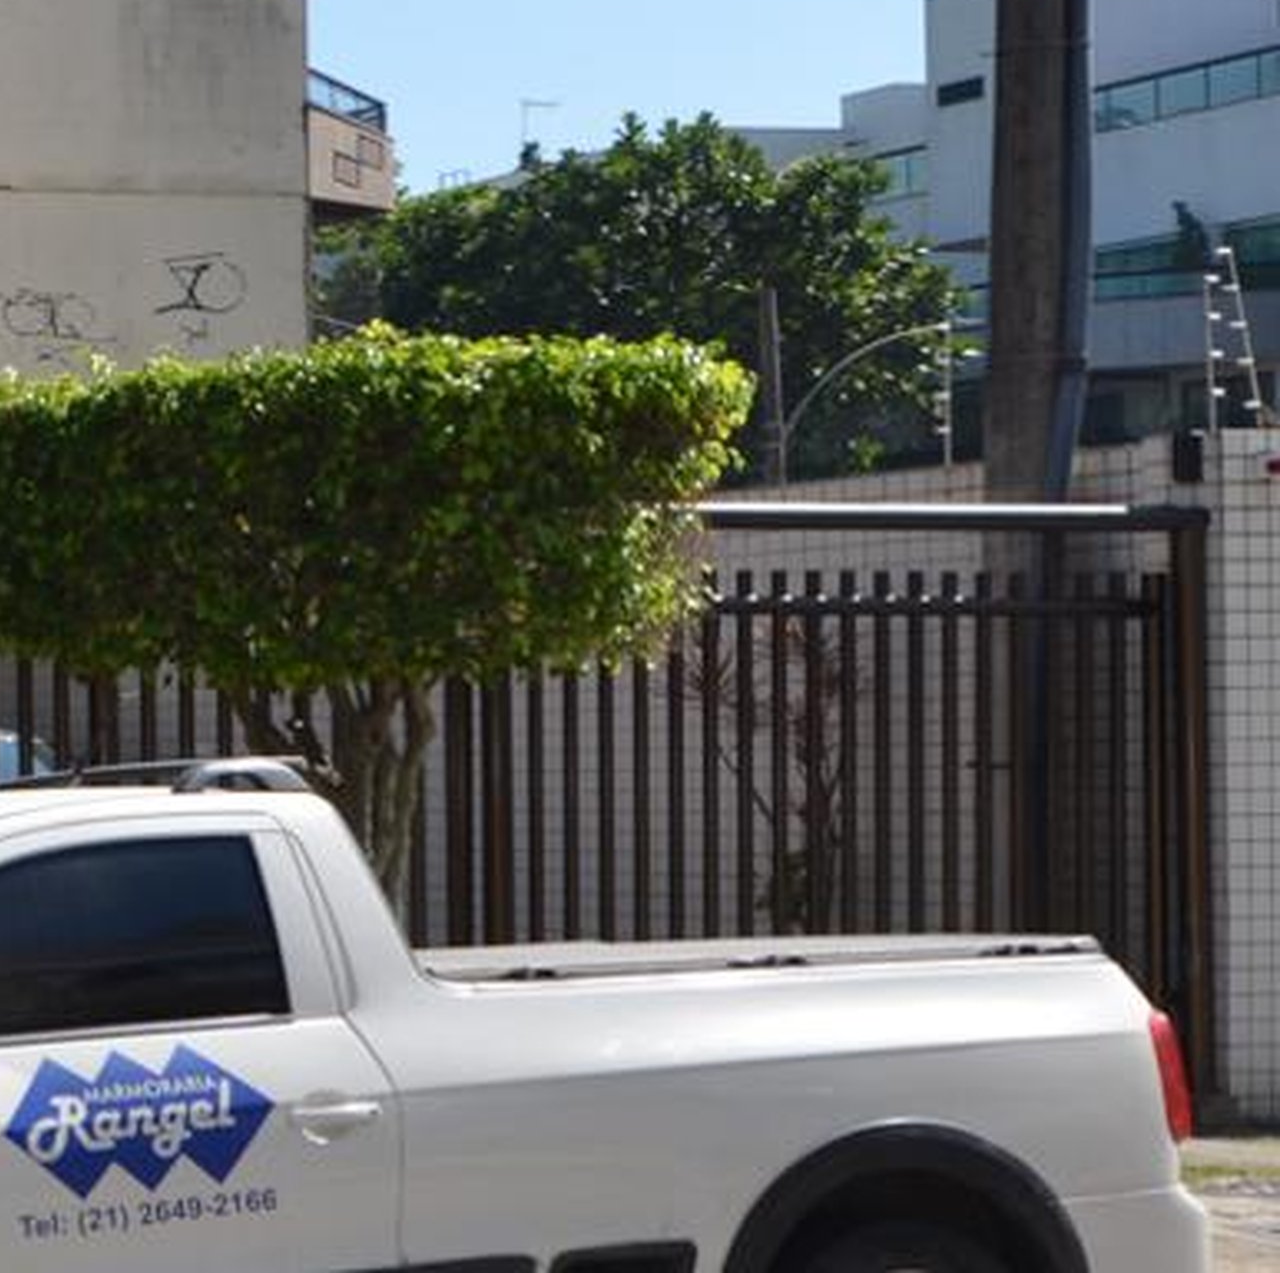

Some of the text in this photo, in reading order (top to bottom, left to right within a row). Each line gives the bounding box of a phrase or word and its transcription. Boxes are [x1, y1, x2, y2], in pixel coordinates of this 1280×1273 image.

[27, 1078, 236, 1163] Rangel
[18, 1188, 278, 1238] Tel: (21) 2649-2166
